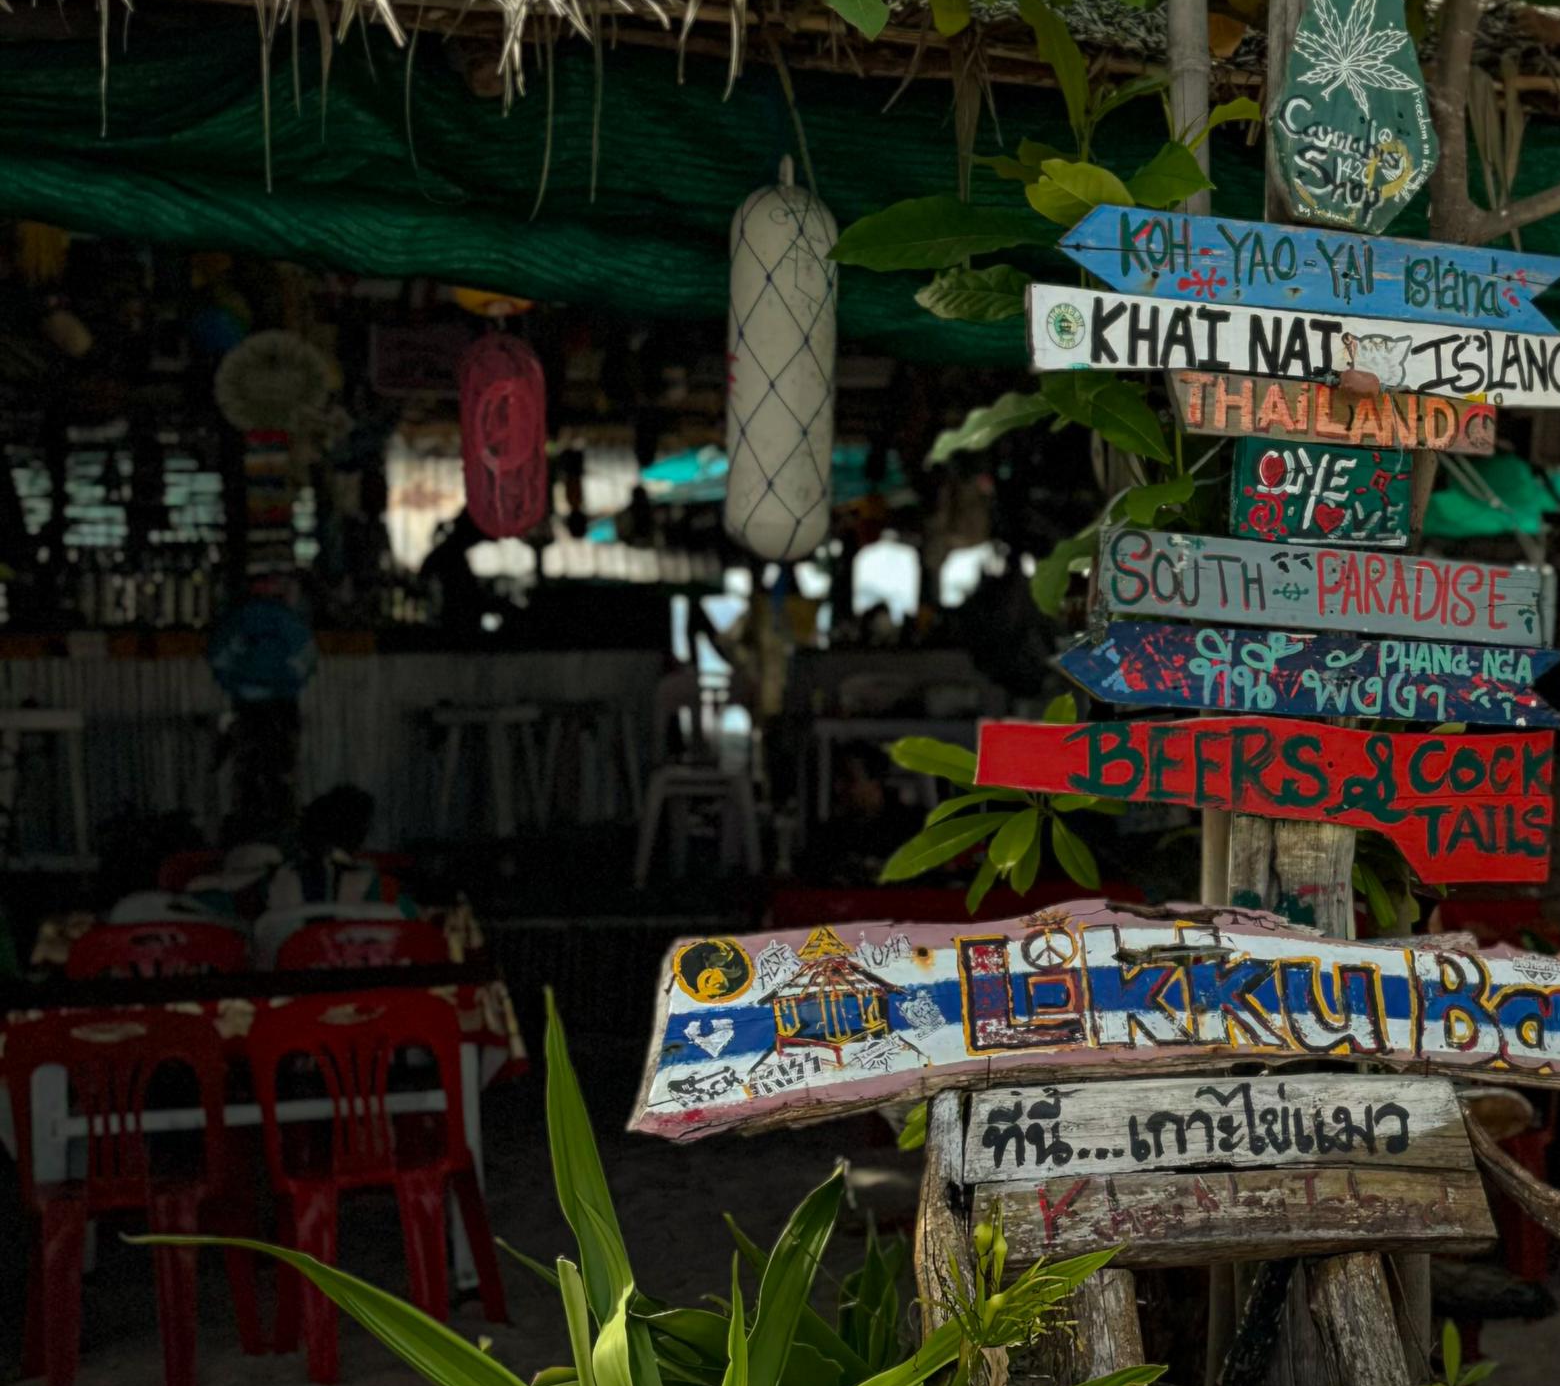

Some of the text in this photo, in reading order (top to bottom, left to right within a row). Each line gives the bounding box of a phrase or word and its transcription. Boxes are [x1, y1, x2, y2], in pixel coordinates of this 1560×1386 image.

[1293, 145, 1386, 227] Shop
[1119, 212, 1192, 277] KOH
[1091, 296, 1232, 370] KHAI
[1248, 313, 1344, 376] NAI
[1109, 529, 1513, 630] SOUTH PARADISE
[1064, 722, 1333, 809] BEERS
[1407, 739, 1554, 797] COCK
[1406, 803, 1552, 860] TAILS
